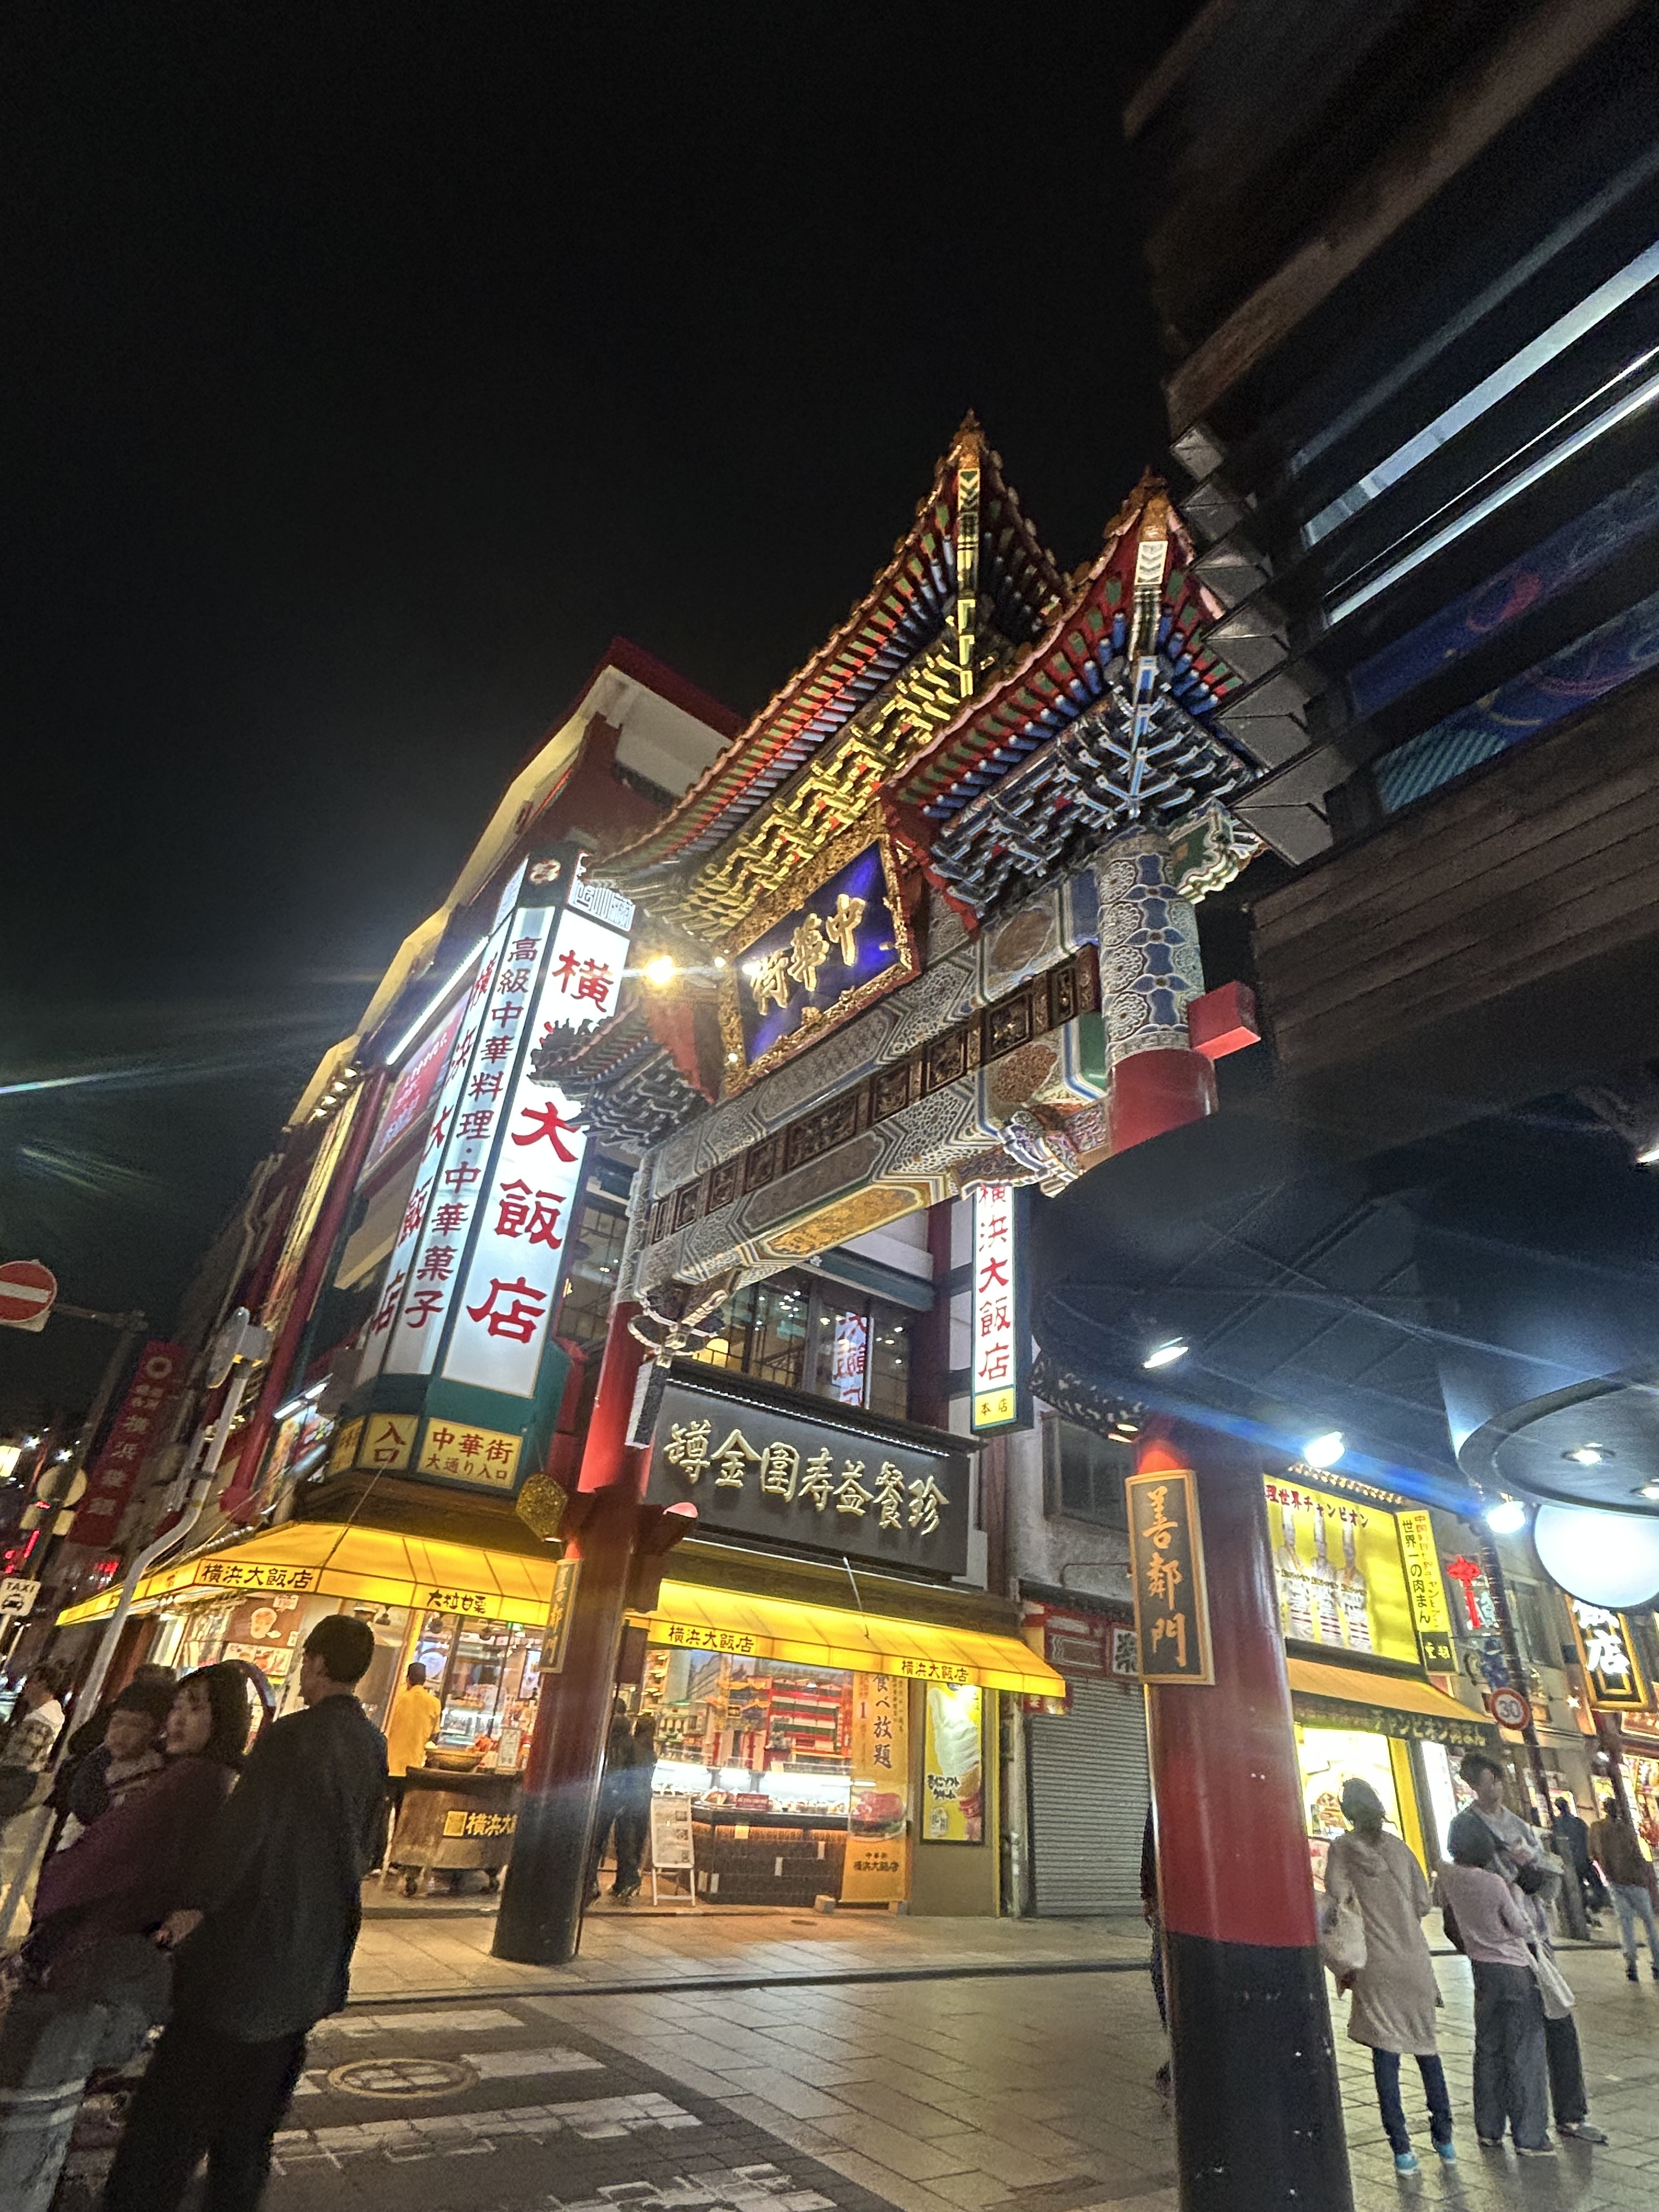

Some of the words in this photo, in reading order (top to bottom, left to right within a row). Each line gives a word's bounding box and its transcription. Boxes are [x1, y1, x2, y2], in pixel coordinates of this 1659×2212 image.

[466, 950, 613, 1343] 横大飯店
[980, 1398, 1008, 1415] 本店
[374, 1421, 406, 1464] 入口
[432, 1427, 514, 1465] 中華街
[426, 1454, 508, 1481] 大通り入口
[200, 1563, 313, 1589] 横浜大飯店
[1403, 1520, 1431, 1624] 世界一の肉まん
[7, 1582, 35, 1593] TAXI
[427, 1589, 486, 1614] 大粒甘栗
[668, 1625, 755, 1654] 横浜大飯店
[901, 1660, 969, 1683] 横浜大飯店
[872, 1673, 893, 1769] 食べ放題
[1498, 1700, 1521, 1719] 30
